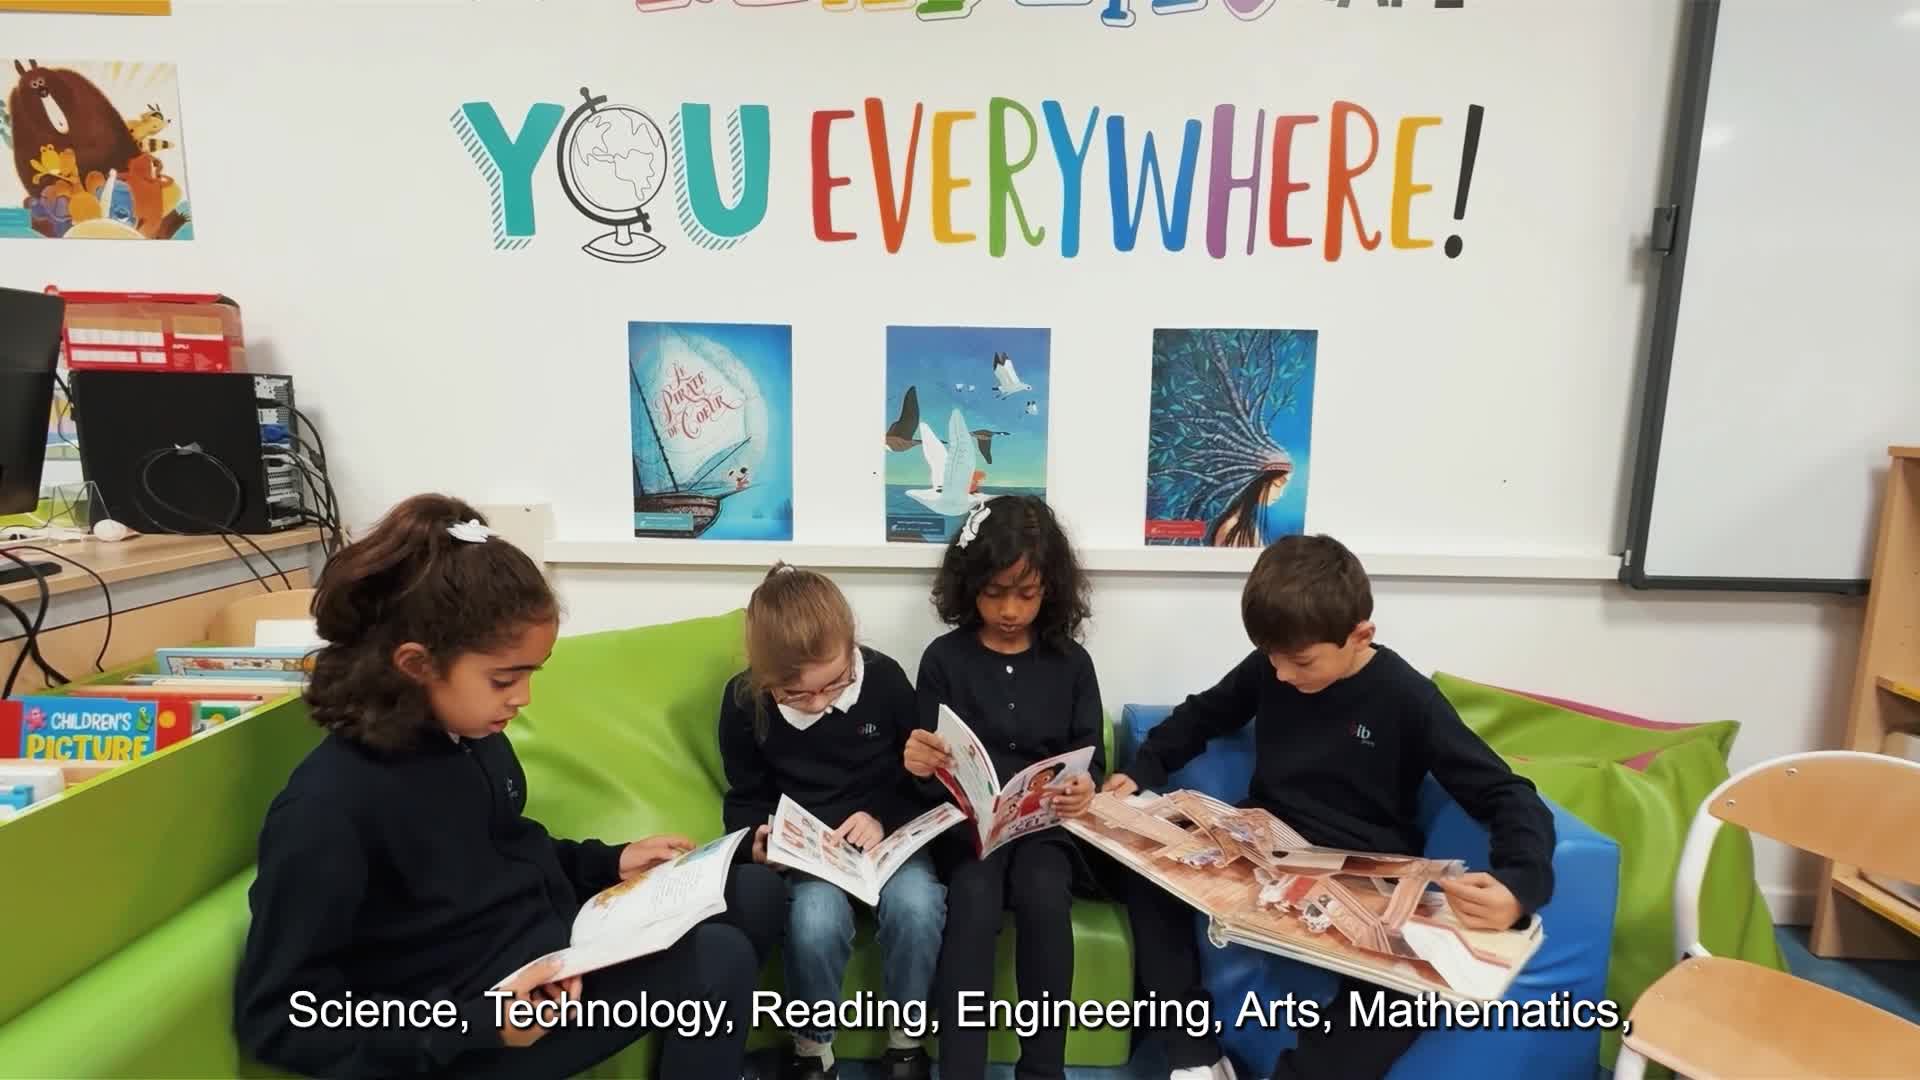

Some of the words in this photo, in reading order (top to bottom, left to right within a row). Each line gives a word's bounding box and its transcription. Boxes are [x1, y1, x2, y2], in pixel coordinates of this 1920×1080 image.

[450, 88, 771, 263] YOU
[812, 97, 1486, 262] EVERYWHERE!
[51, 711, 132, 731] CHILDREN'S
[26, 735, 150, 761] PICTURE
